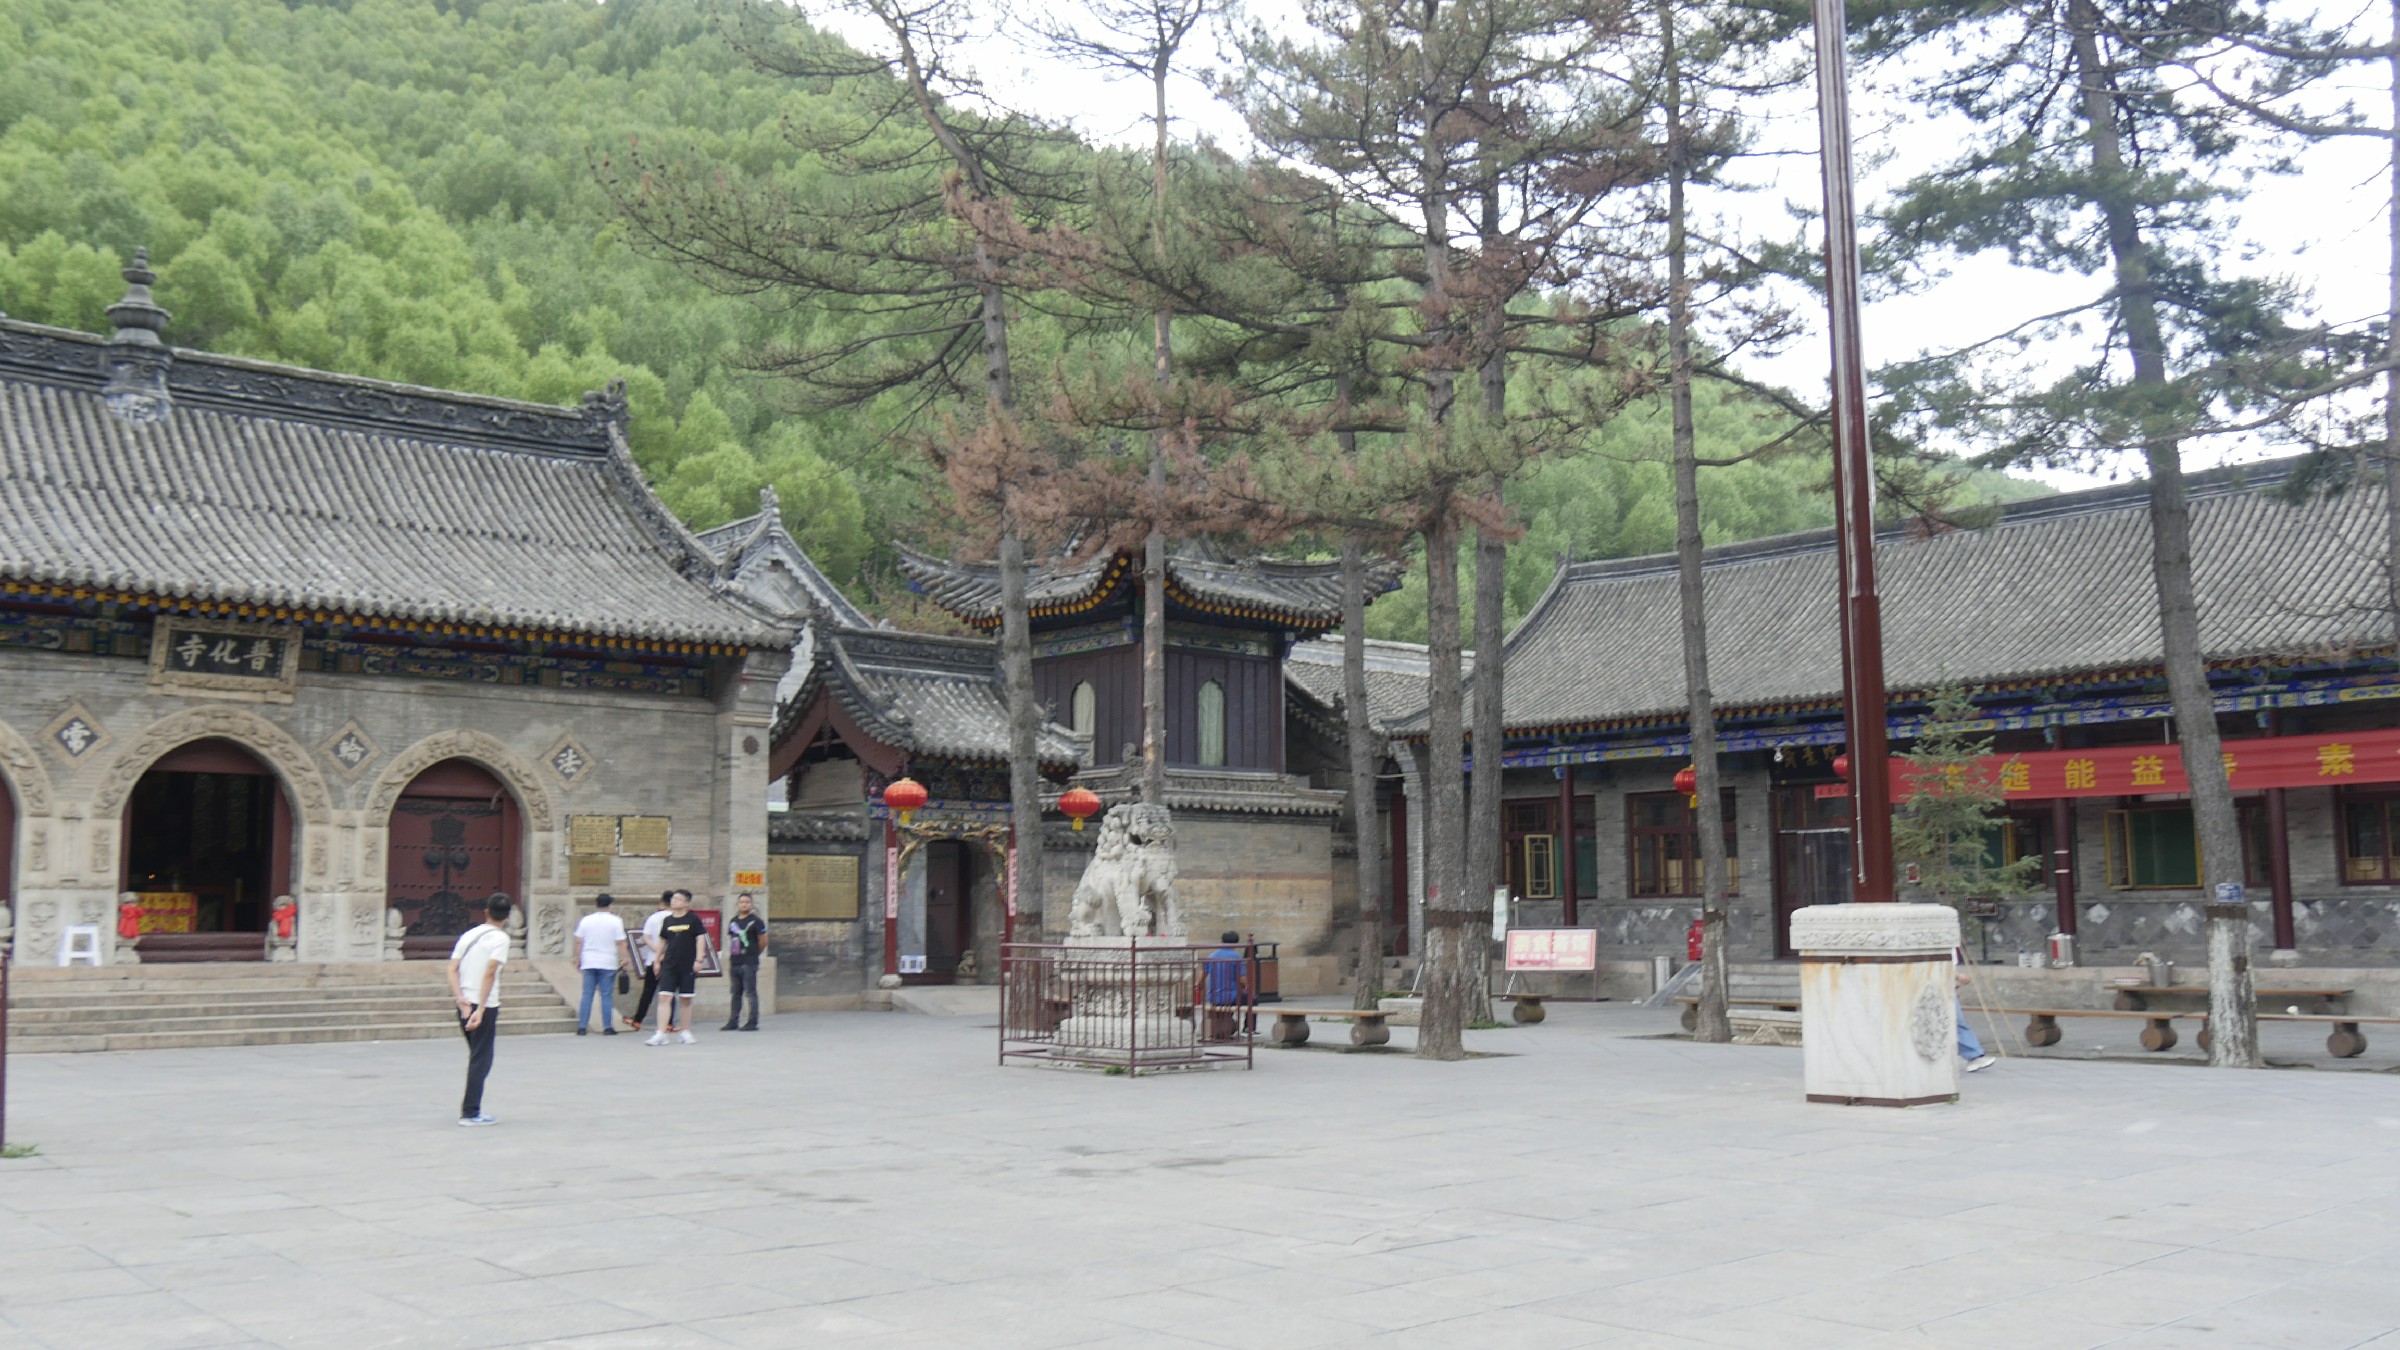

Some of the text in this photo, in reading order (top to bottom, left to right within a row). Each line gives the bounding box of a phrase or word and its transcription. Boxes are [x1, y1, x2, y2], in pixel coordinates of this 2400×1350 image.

[175, 632, 275, 672] 普化寺
[557, 747, 583, 774] 法
